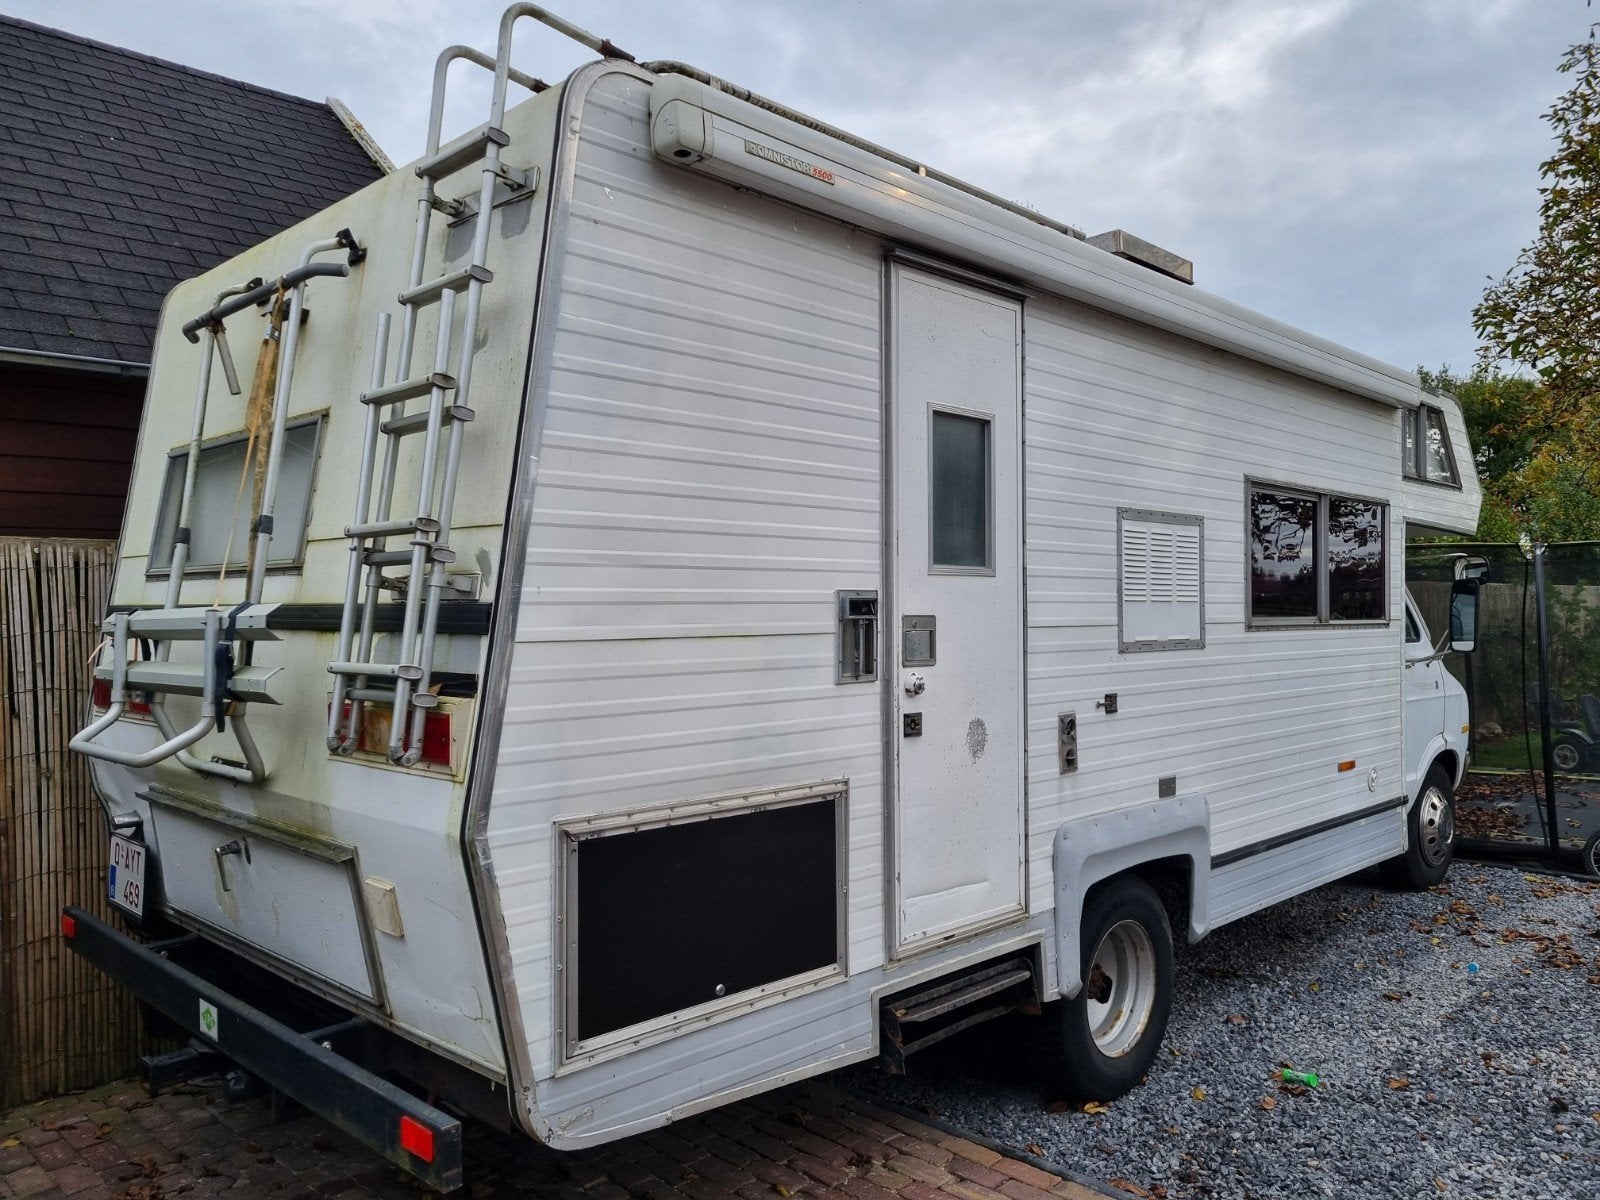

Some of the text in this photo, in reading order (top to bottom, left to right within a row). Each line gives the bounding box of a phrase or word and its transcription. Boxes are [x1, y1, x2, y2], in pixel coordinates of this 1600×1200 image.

[758, 145, 833, 181] OMNISTOR 5500
[123, 879, 140, 908] 469
